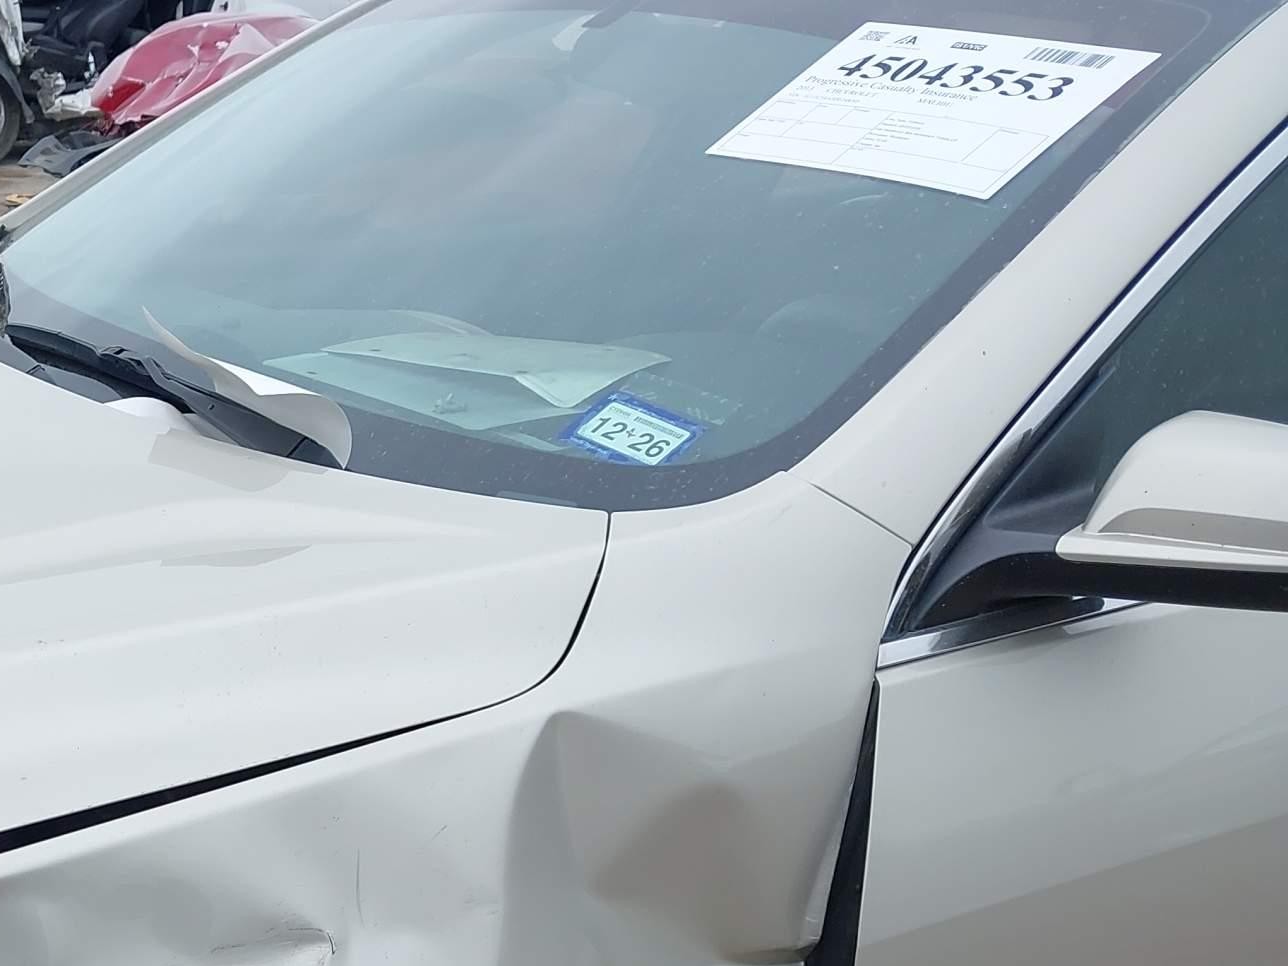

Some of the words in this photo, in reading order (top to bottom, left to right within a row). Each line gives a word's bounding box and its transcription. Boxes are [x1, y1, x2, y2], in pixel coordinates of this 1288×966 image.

[805, 75, 869, 90] Progressive
[870, 82, 919, 95] Casualty
[921, 86, 979, 102] Insurance
[837, 53, 1075, 102] 45043553
[590, 416, 629, 441] 12
[627, 432, 671, 458] 26
